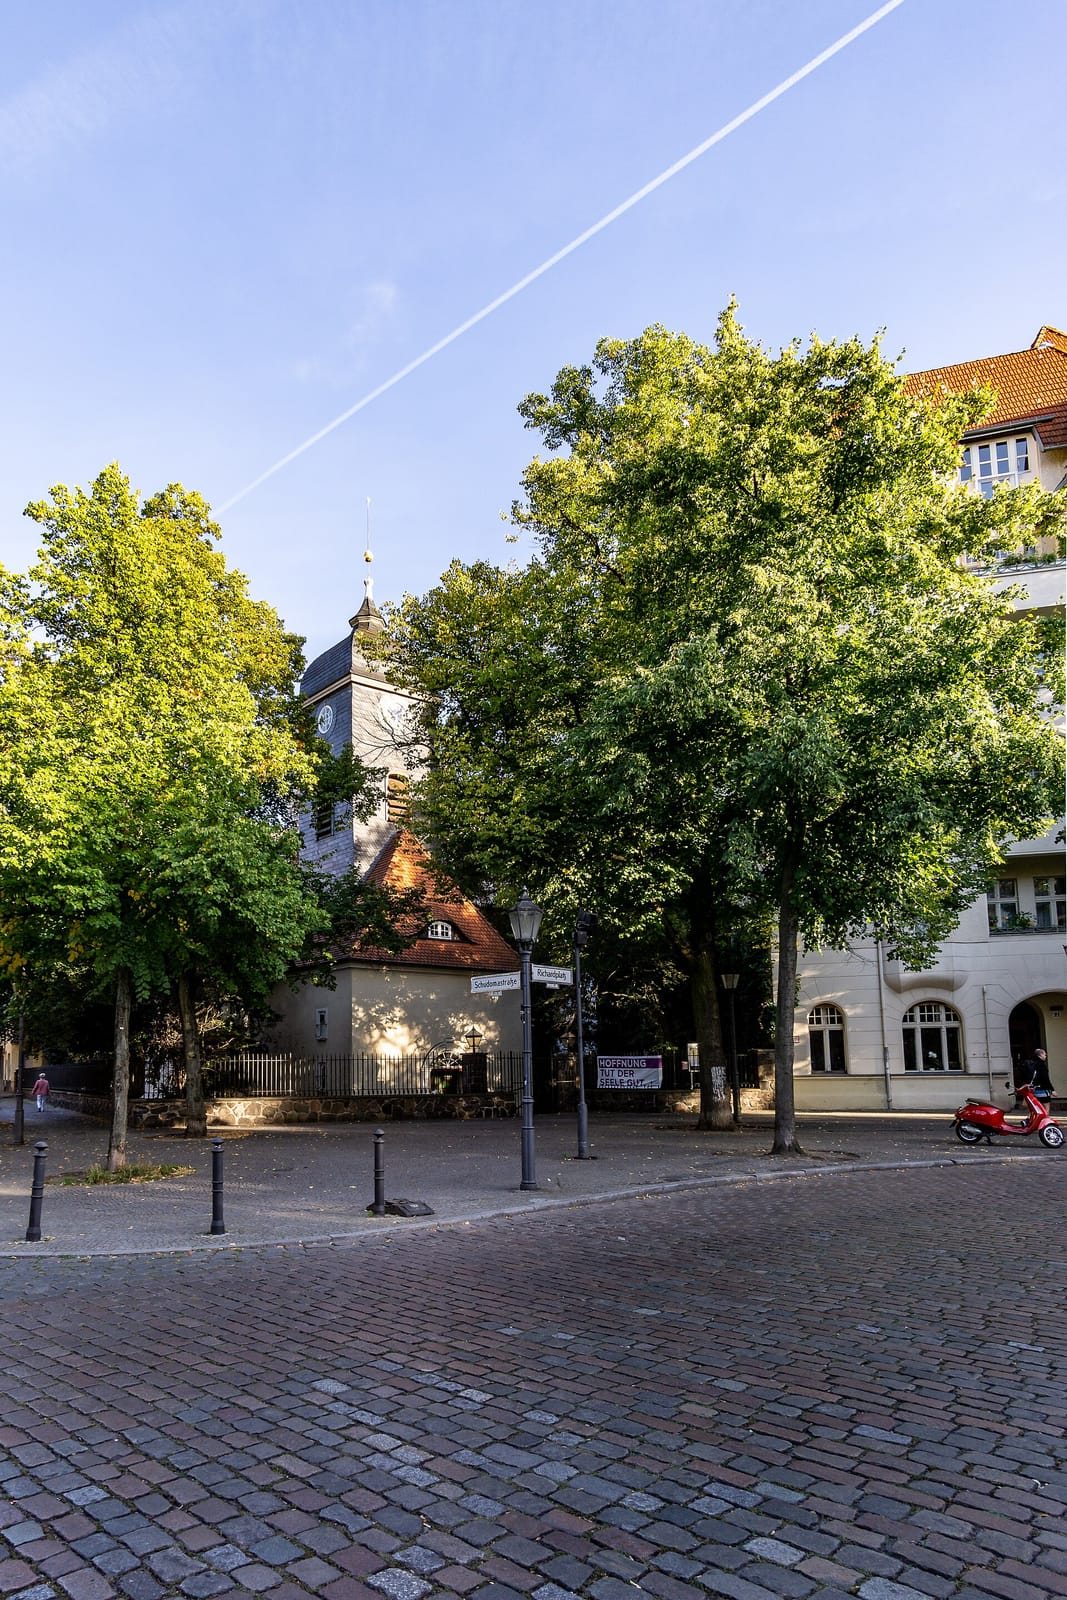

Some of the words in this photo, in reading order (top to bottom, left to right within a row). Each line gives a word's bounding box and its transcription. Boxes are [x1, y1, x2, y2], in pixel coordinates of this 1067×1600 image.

[537, 969, 566, 981] Richardplatz
[474, 978, 517, 989] Schudomastraße
[600, 1059, 647, 1068] HOFFNUNG
[600, 1069, 615, 1077] TUT
[617, 1069, 635, 1077] DER
[600, 1078, 625, 1086] SEELE
